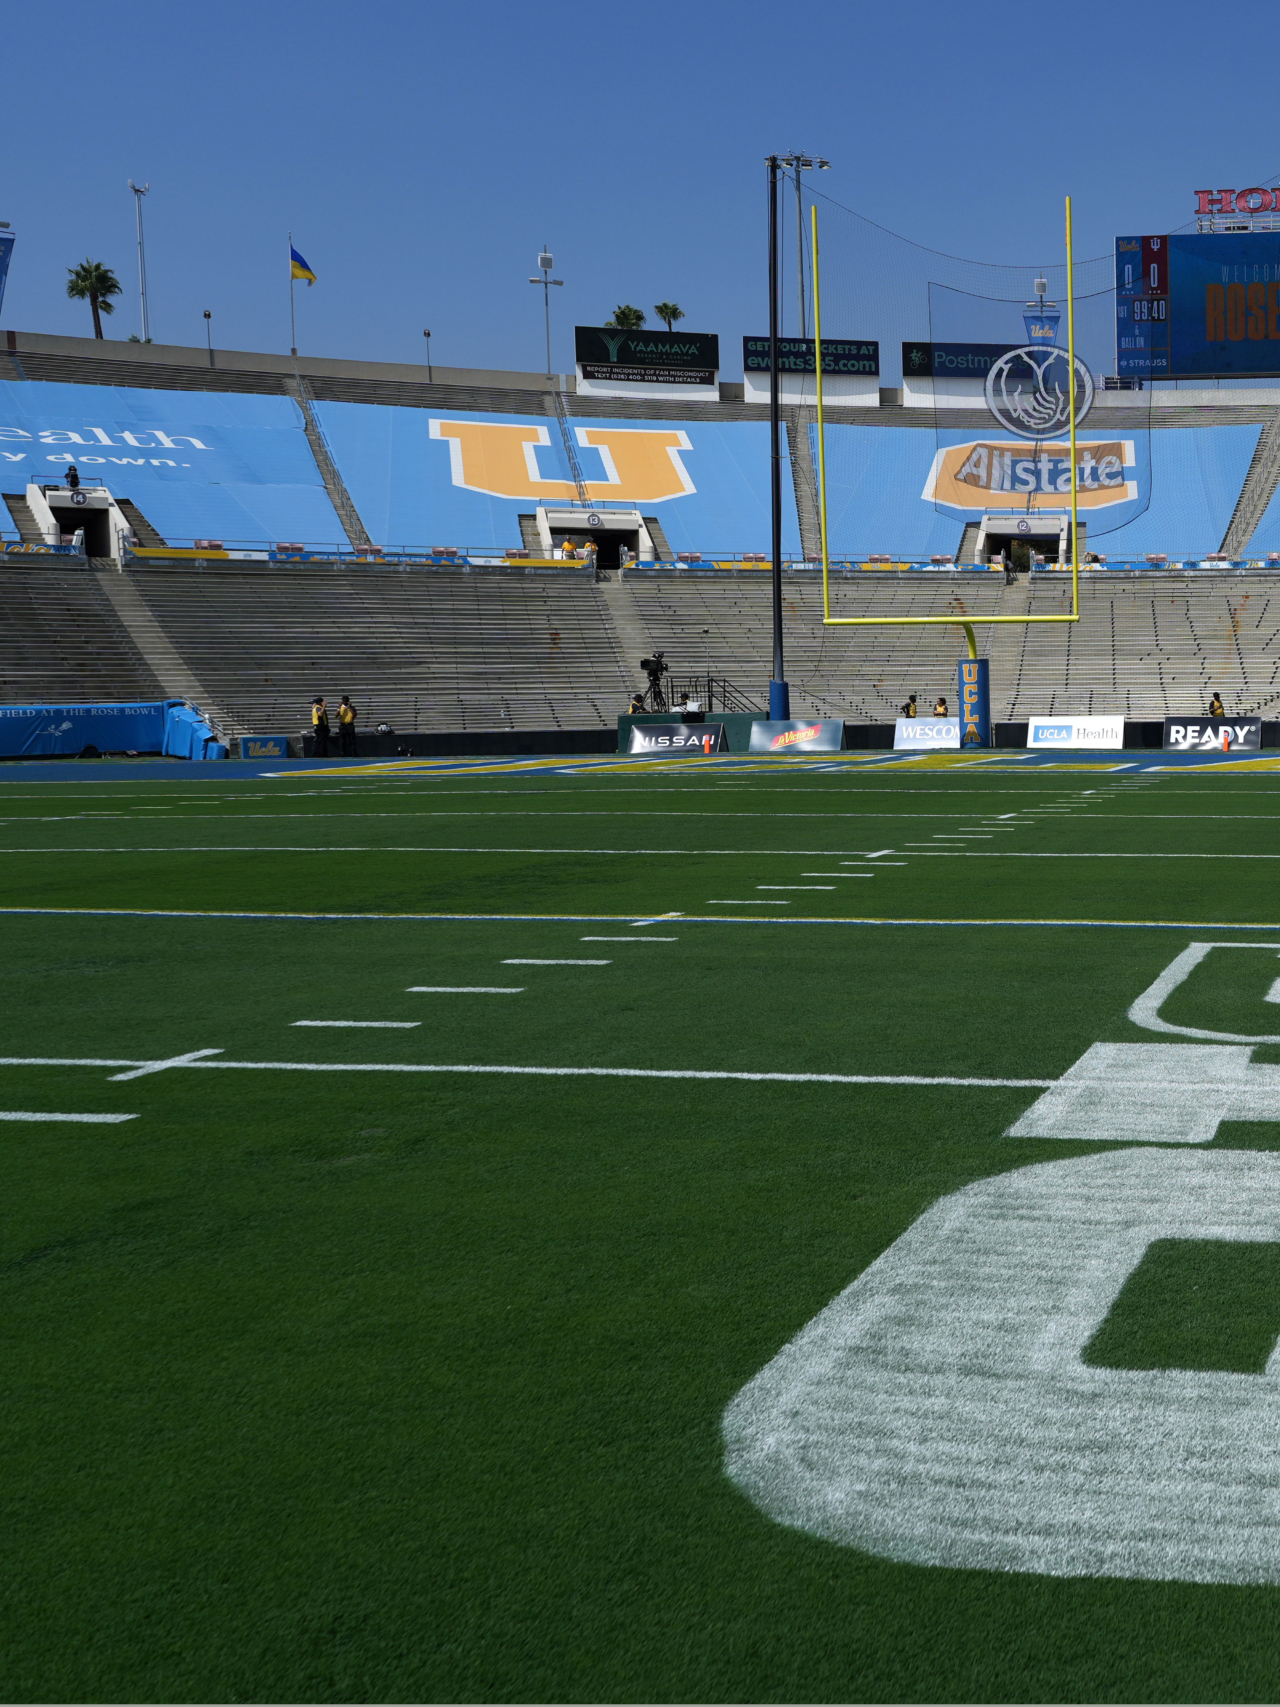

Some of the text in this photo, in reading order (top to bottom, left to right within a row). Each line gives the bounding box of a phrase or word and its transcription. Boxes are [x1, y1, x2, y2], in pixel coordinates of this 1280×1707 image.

[1125, 264, 1132, 288] 0
[1150, 263, 1158, 287] 0
[1117, 306, 1127, 317] 1ST
[1134, 300, 1166, 320] 99:40
[1031, 324, 1055, 338] Ucla
[748, 341, 875, 355] GET OUR TCKETS AT
[1121, 337, 1144, 348] BALL ON
[748, 355, 876, 372] evnts35.com
[934, 351, 1028, 369] Postmes
[1129, 359, 1167, 367] STRAUSS
[612, 367, 645, 375] INCIDENTS
[669, 370, 709, 378] MISCONDUCT
[46, 453, 192, 467] down.
[957, 446, 1123, 492] Allstate
[73, 494, 84, 503] 14
[590, 515, 599, 525] 13
[1018, 522, 1027, 531] 12
[962, 663, 981, 743] UCLA
[0, 707, 158, 718] FIELD AT THE ROSE BOWL
[637, 734, 715, 746] NISSAN
[1038, 727, 1119, 740] UCLA Health
[248, 742, 282, 757] Ucla
